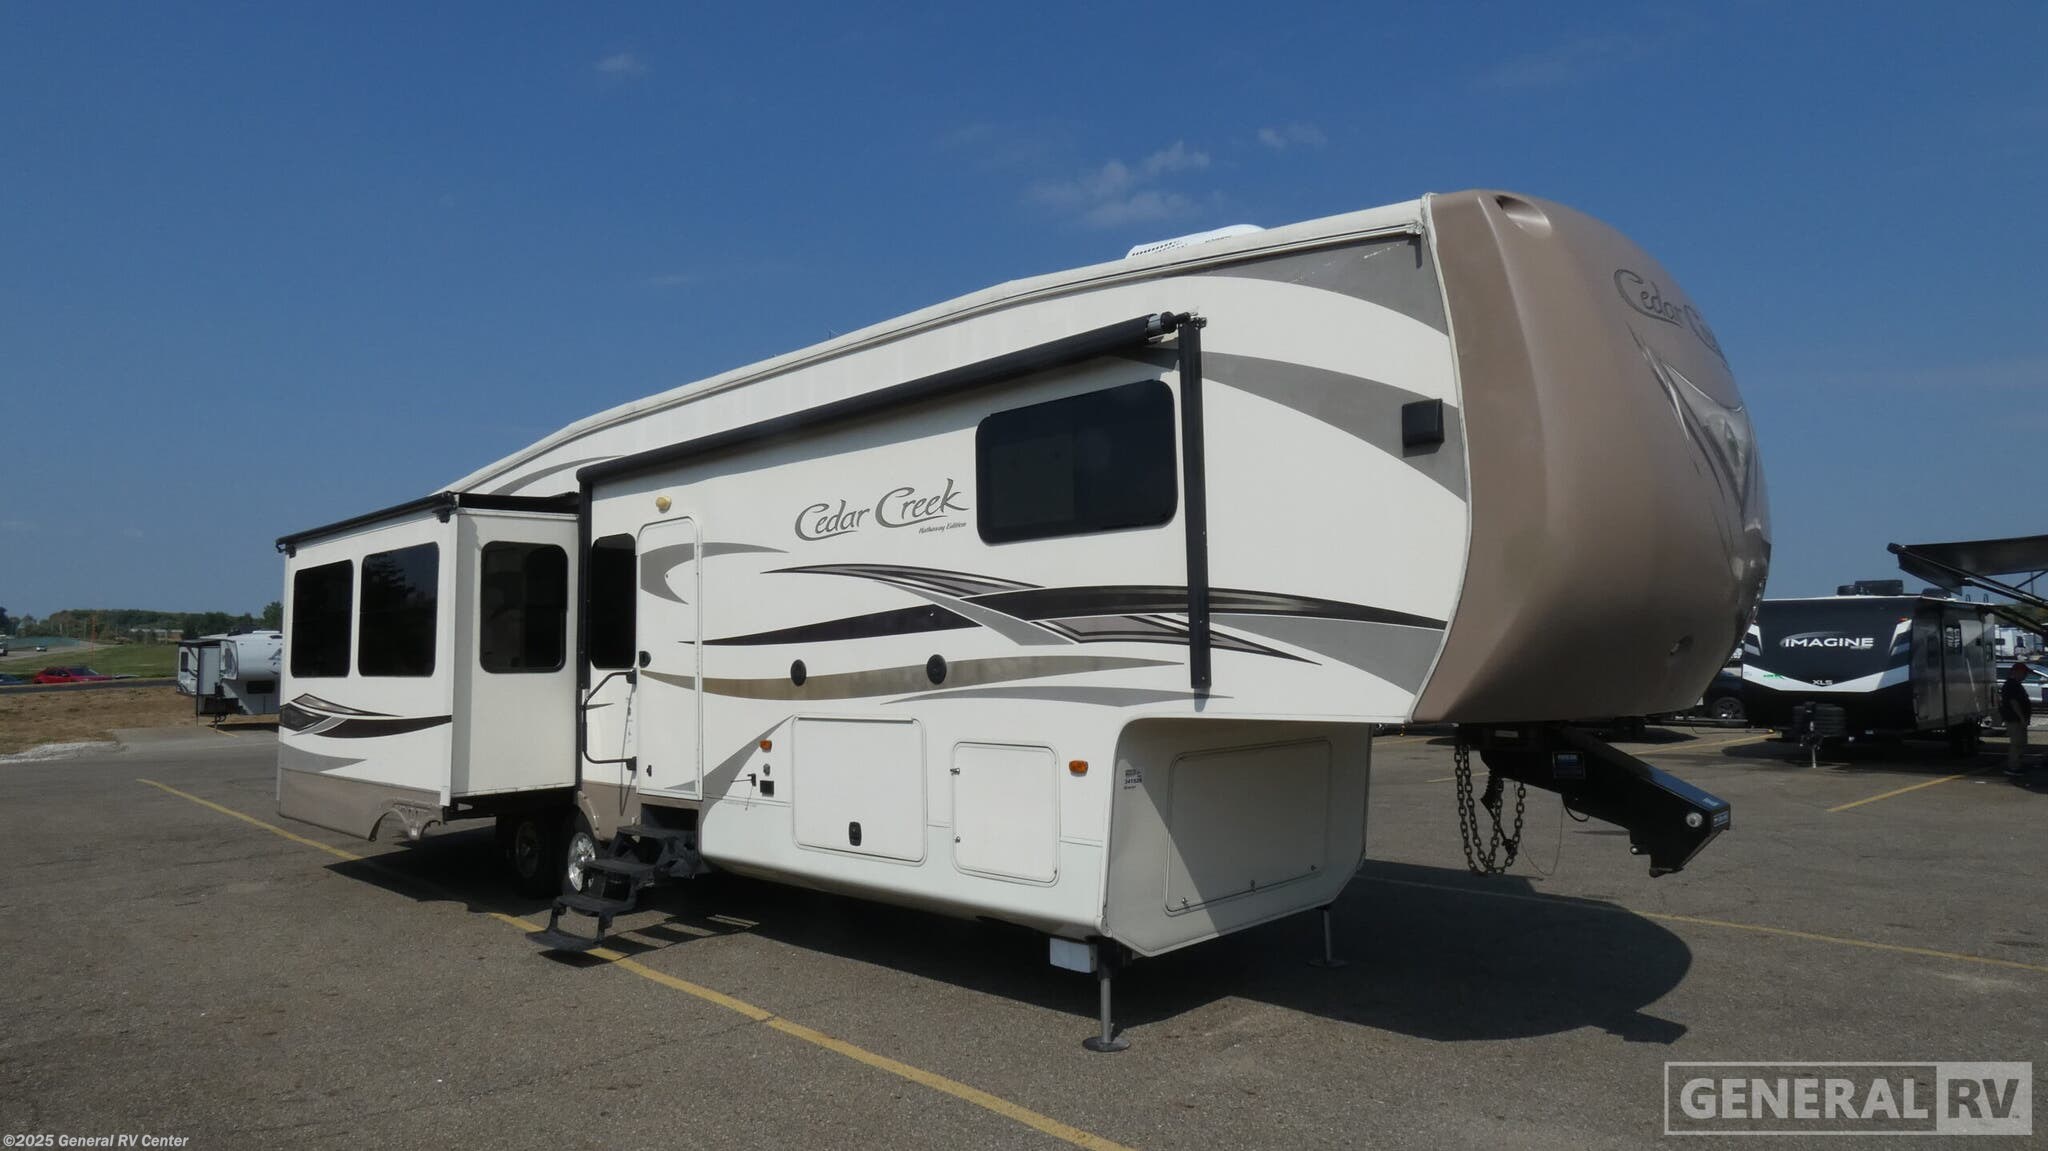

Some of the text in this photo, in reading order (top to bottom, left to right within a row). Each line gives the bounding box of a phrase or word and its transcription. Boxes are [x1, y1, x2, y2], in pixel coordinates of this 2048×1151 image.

[1614, 269, 1684, 328] Cedar
[795, 477, 970, 542] Cedar Creek
[1785, 637, 1874, 647] IMAGINE
